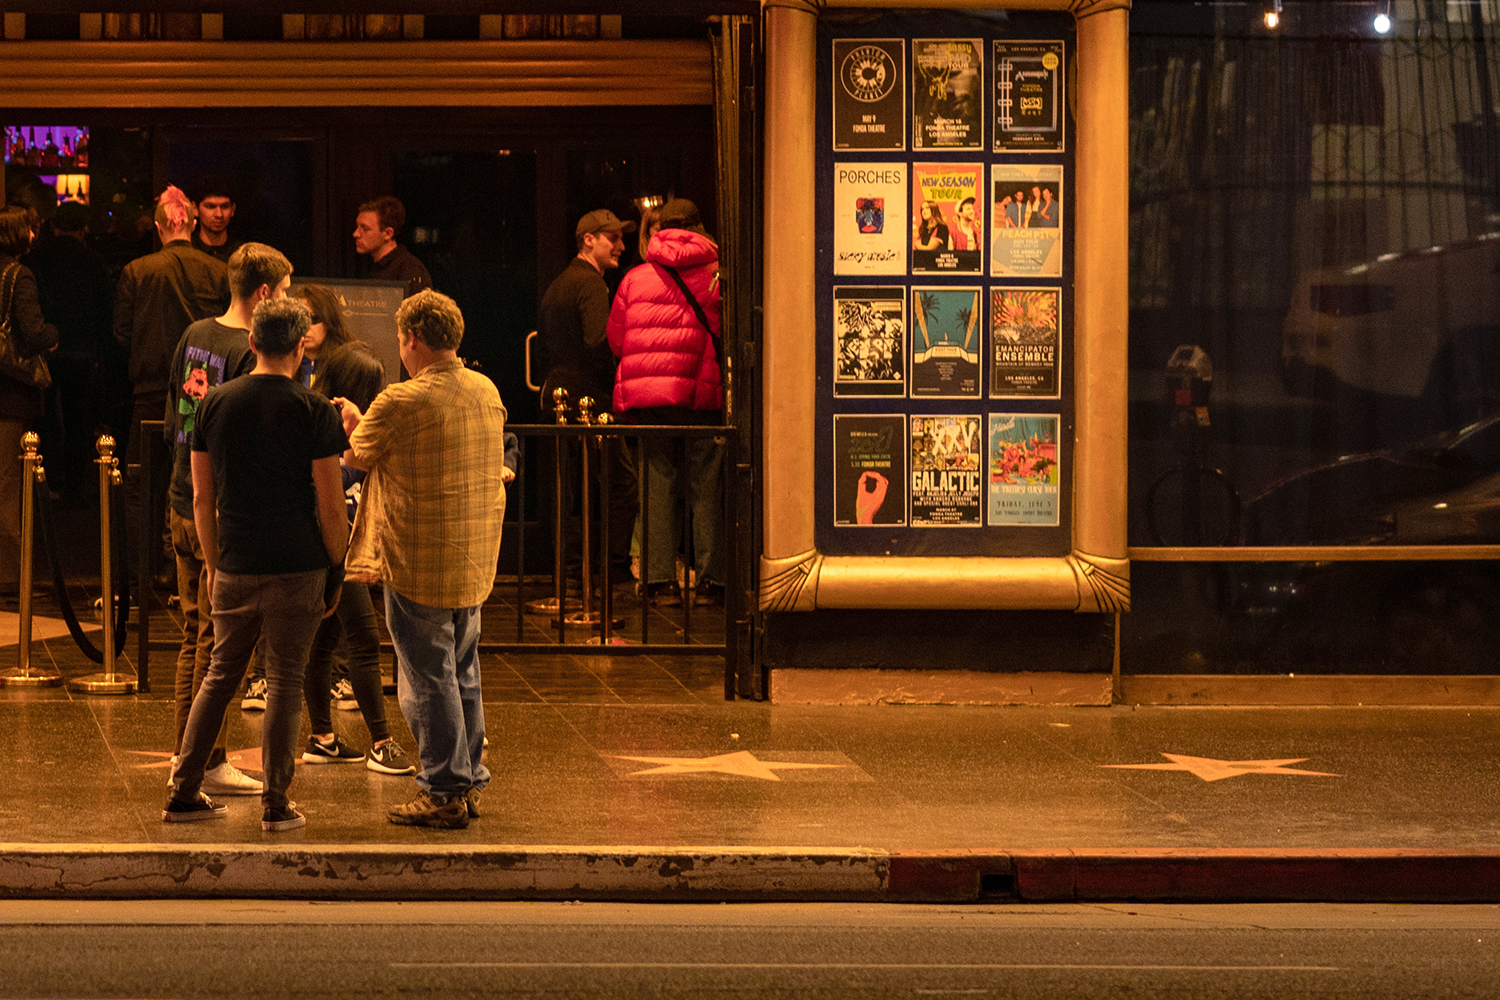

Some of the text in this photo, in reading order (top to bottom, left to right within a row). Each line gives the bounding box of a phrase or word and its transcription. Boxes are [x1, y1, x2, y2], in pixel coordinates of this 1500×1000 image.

[850, 48, 886, 60] PHANTOM
[853, 89, 884, 100] PLANET
[853, 124, 886, 133] FONDA THEATRE
[839, 170, 901, 184] PORCHES
[922, 176, 976, 187] NEW SEASON
[930, 188, 963, 199] TOUR
[1002, 229, 1050, 240] PEACH PIT
[348, 301, 387, 309] THEATRE
[995, 345, 1054, 353] EMANCIPATOR
[995, 352, 1054, 362] ENSEMBLE
[912, 471, 980, 492] GALACTIC
